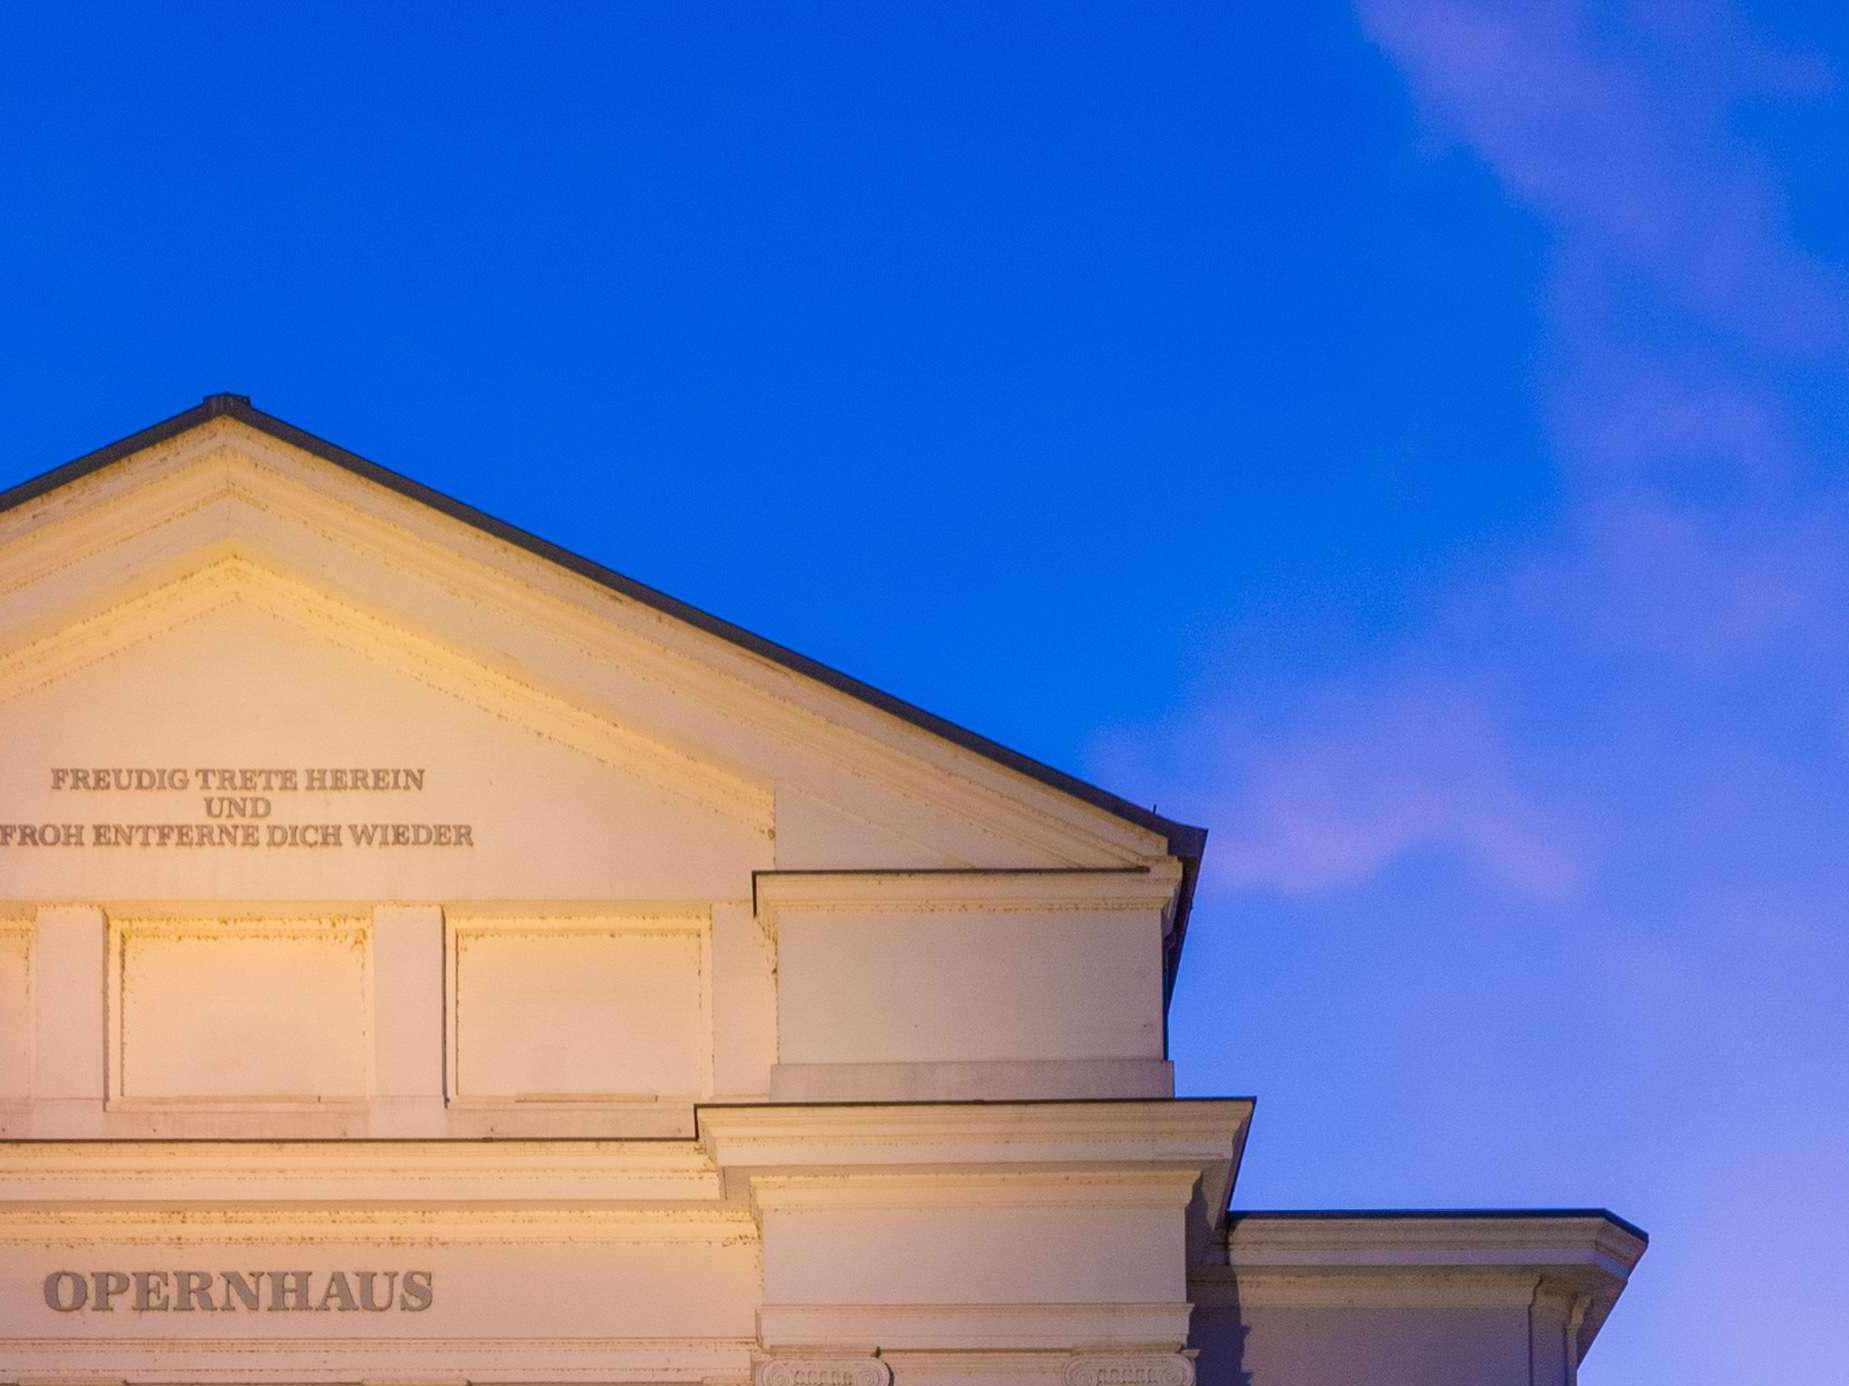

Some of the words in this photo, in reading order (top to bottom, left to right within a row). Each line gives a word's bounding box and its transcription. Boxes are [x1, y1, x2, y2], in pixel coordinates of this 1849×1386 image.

[50, 768, 190, 792] FREUDIG
[195, 768, 298, 792] TRETE
[304, 768, 425, 791] HEREIN
[204, 797, 271, 818] UND
[92, 824, 261, 847] ENTFERNE
[267, 824, 343, 847] DICH
[348, 824, 474, 847] WIEDER
[42, 1269, 435, 1312] OPERNHAUS
